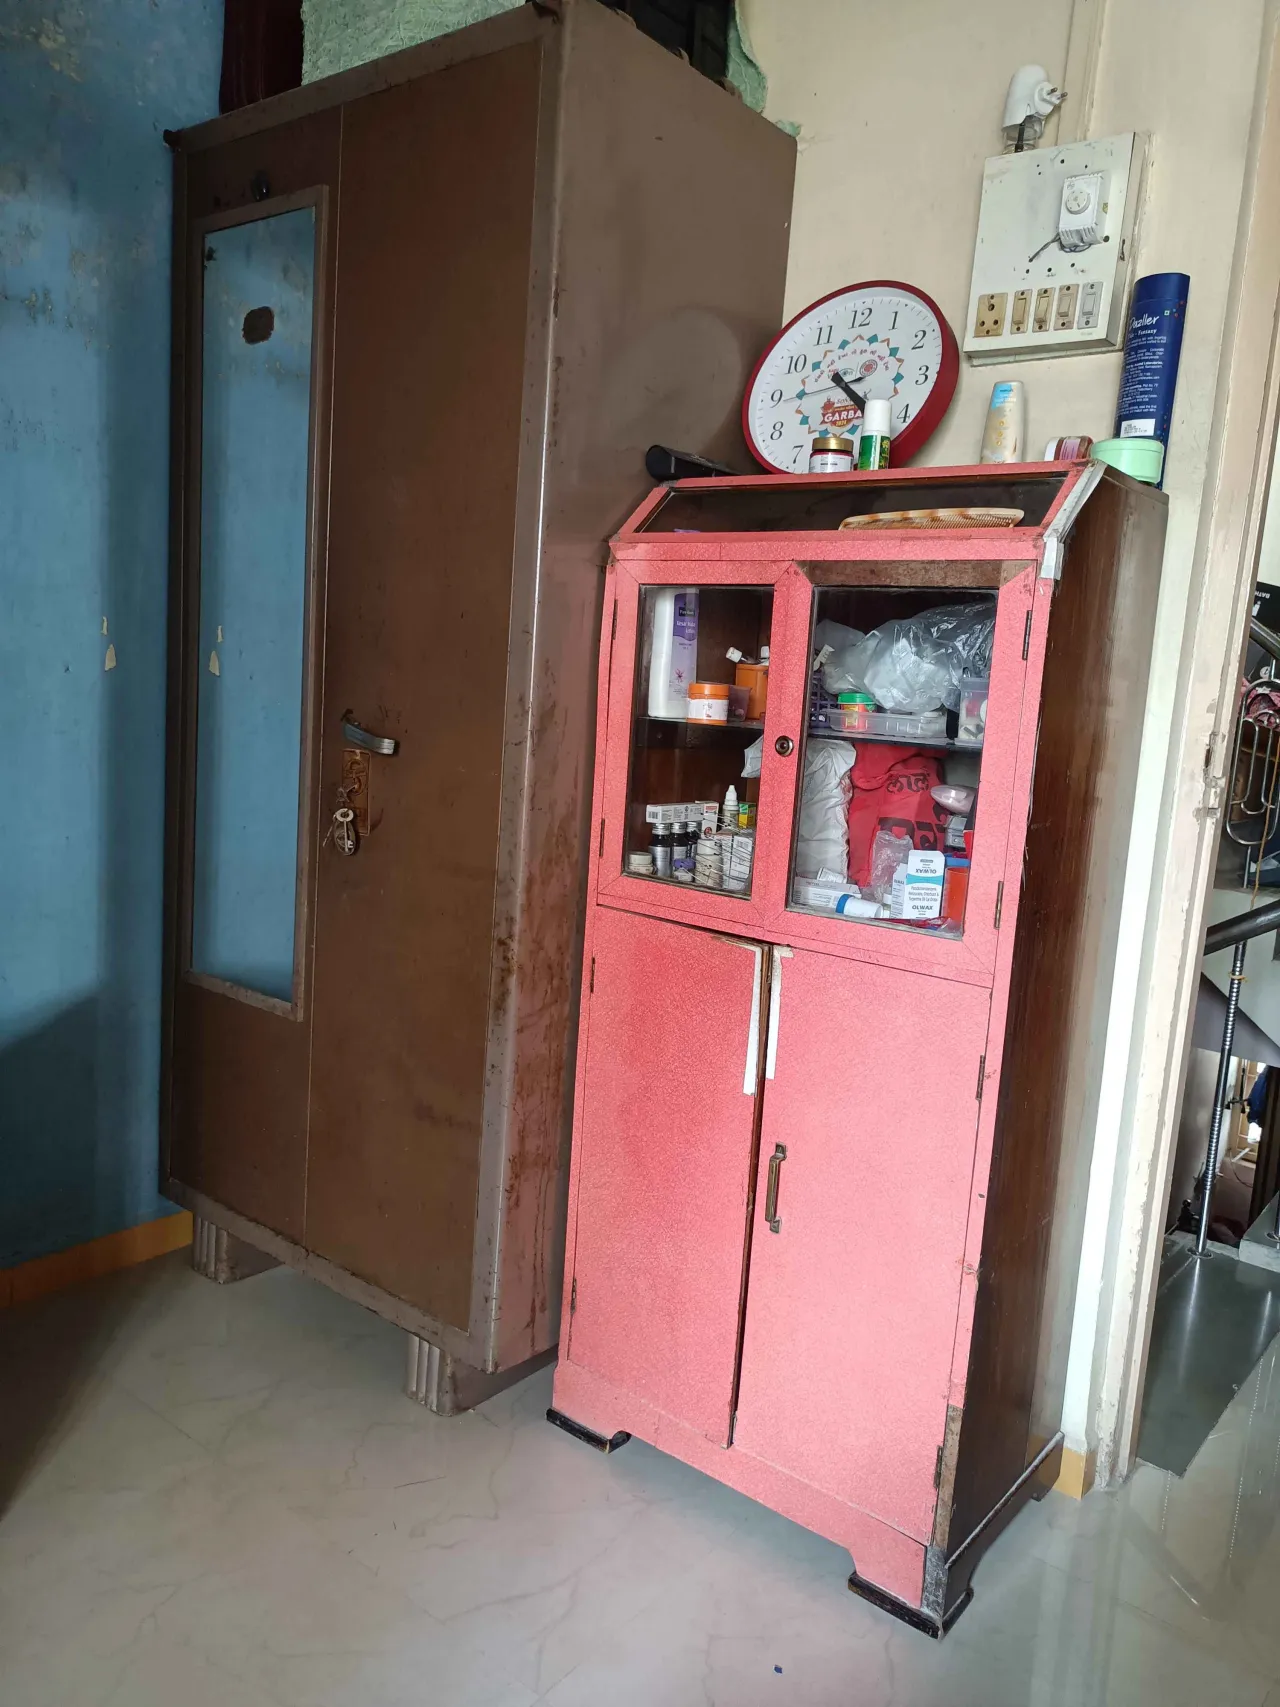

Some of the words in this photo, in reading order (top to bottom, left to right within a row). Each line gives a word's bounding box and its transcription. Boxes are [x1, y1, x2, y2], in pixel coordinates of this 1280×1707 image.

[848, 307, 873, 330] 12
[888, 310, 899, 331] 1
[813, 325, 834, 347] 11
[911, 329, 927, 351] 2
[784, 353, 808, 376] 10
[914, 364, 929, 386] 3
[769, 388, 784, 409] 9
[824, 410, 863, 422] GARBA
[896, 403, 911, 424] 4
[769, 420, 784, 441] 8
[791, 444, 805, 465] 7
